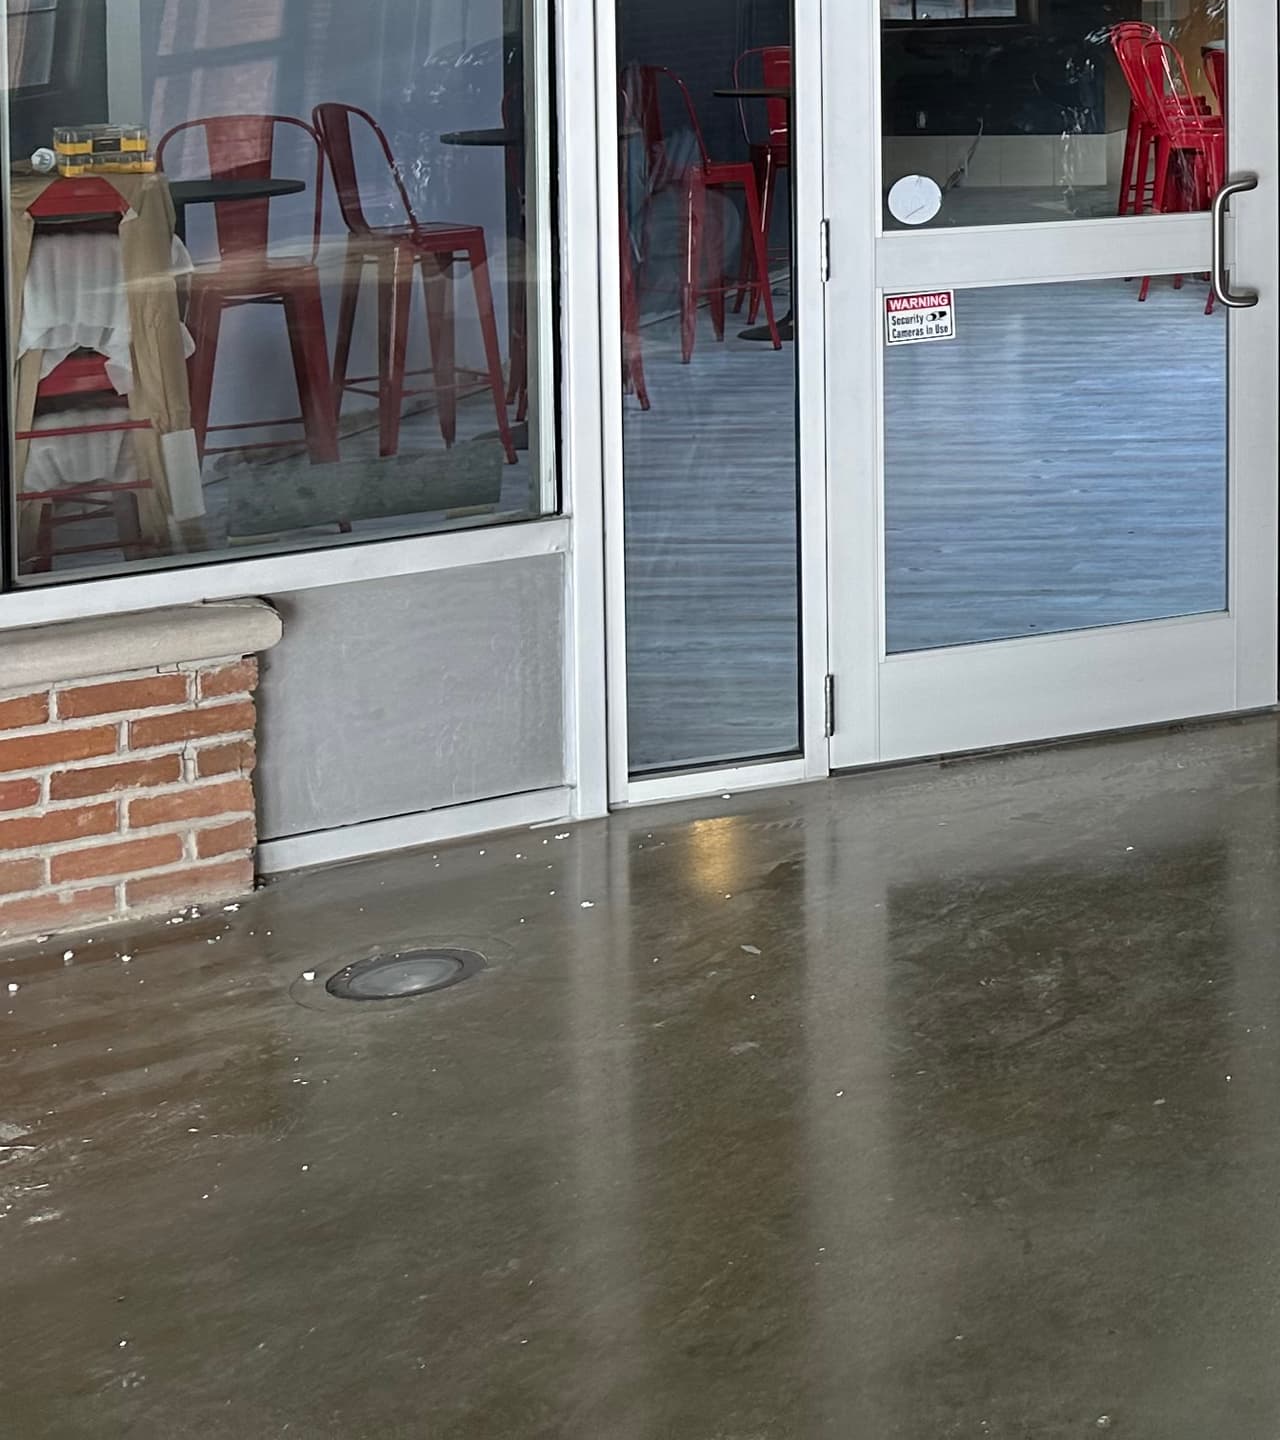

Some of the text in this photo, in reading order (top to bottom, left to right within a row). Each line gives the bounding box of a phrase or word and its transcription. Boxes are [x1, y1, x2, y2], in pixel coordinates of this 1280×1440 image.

[889, 294, 949, 310] WARNING
[891, 314, 924, 326] Security
[892, 328, 924, 339] Cameras
[935, 324, 949, 334] Use
